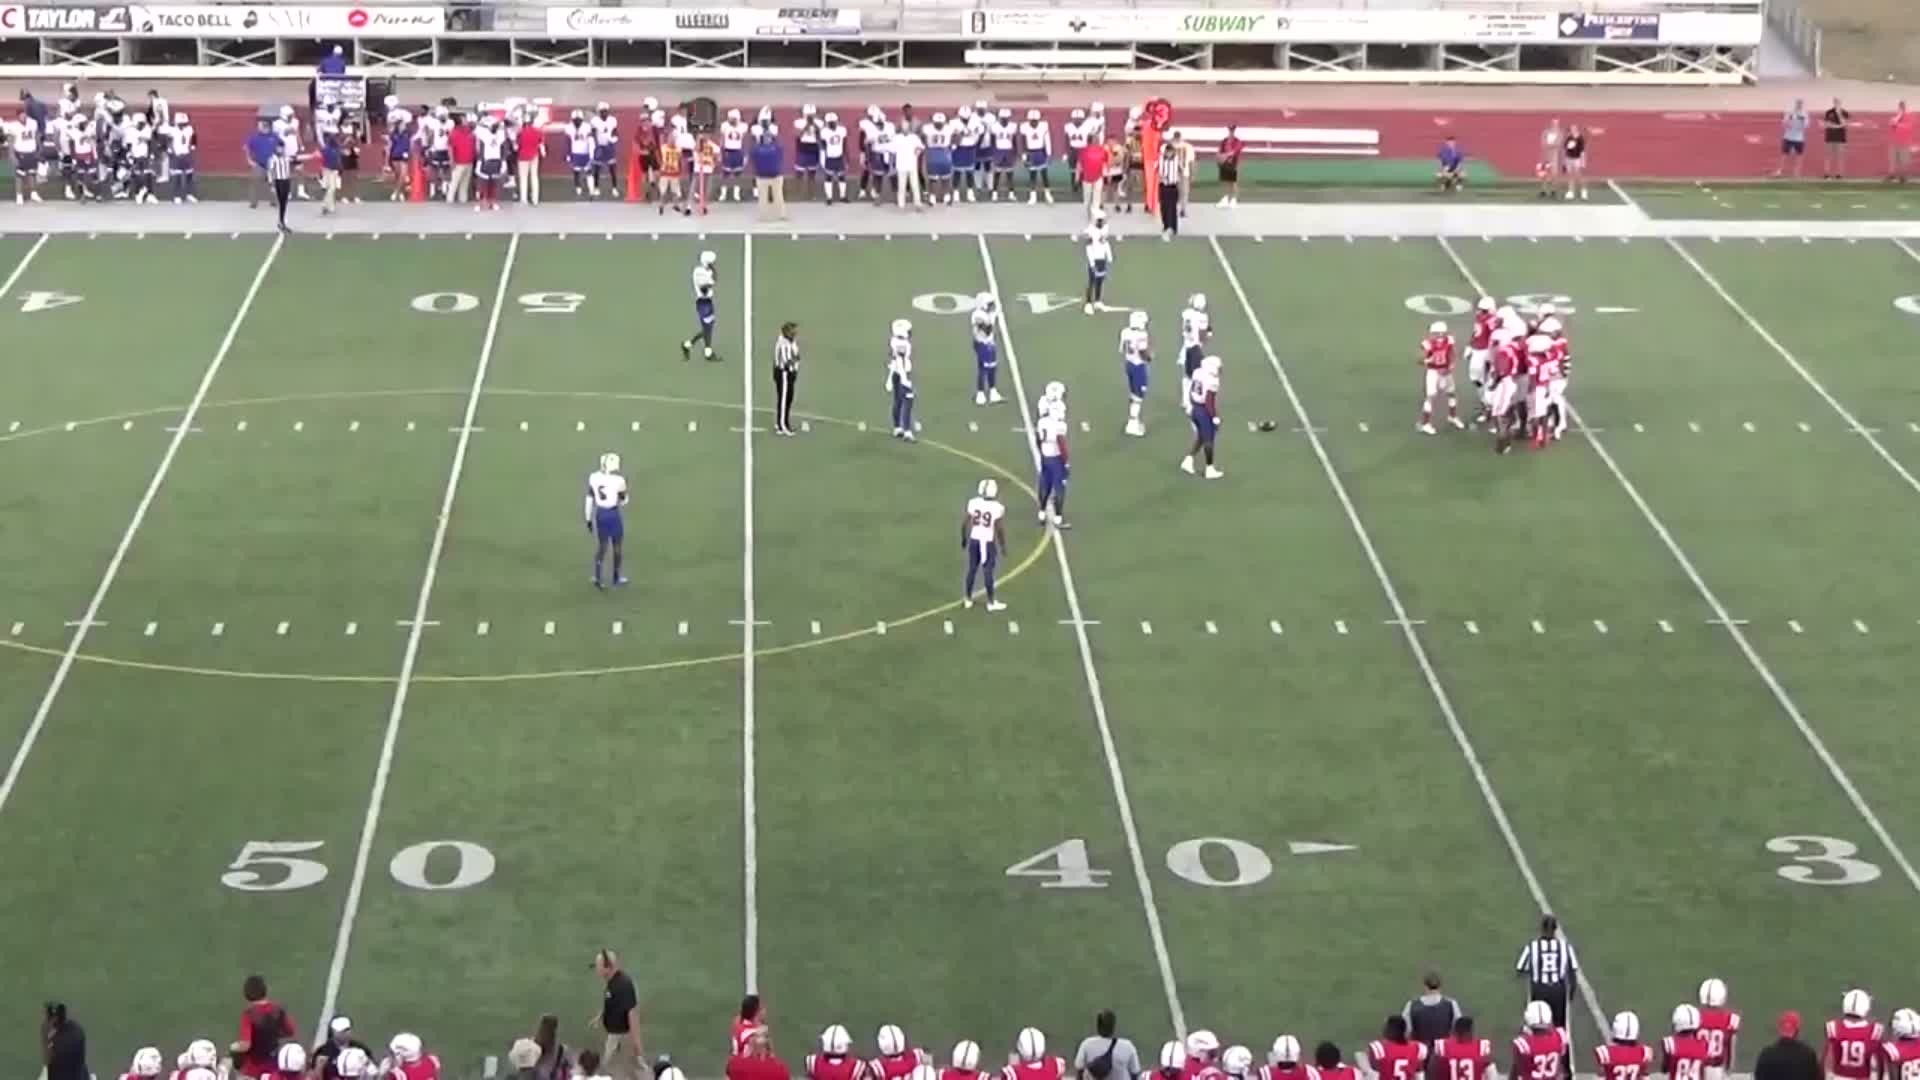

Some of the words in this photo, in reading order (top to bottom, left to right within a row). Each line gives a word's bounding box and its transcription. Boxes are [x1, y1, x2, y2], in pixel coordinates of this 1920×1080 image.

[27, 9, 96, 29] TAYLOR
[158, 14, 195, 27] TACO
[199, 14, 232, 26] BELL
[1181, 15, 1259, 32] SUBWAY
[972, 509, 992, 528] 29
[1765, 835, 1881, 885] 3
[1542, 953, 1558, 972] H
[1840, 1039, 1866, 1066] 19
[1449, 1057, 1475, 1080] 13
[1531, 1052, 1559, 1078] 33
